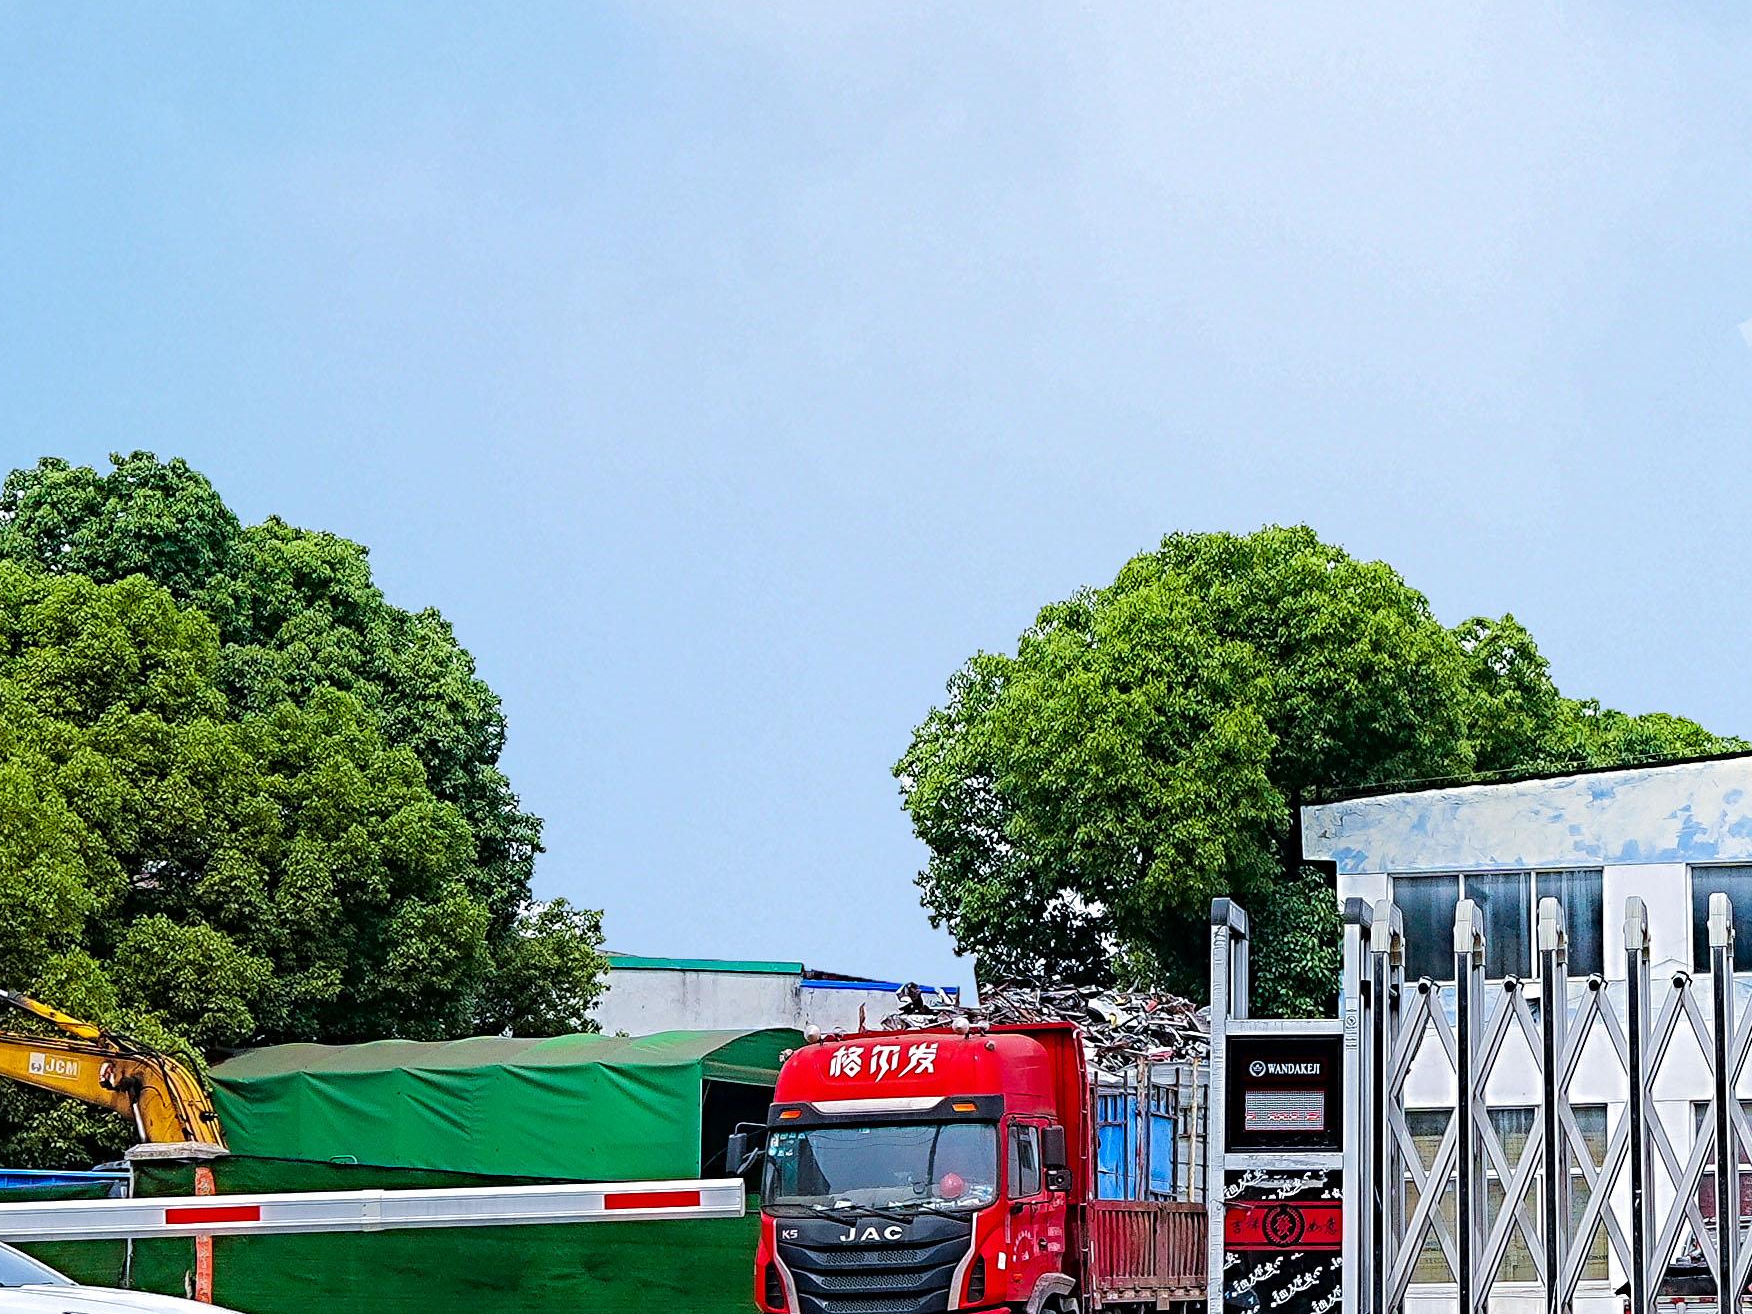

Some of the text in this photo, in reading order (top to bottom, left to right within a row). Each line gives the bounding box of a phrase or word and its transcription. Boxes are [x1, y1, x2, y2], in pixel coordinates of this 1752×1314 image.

[829, 1042, 939, 1083] 格尔发
[1267, 1063, 1321, 1075] WANDAKEJI
[839, 1225, 904, 1243] JAC
